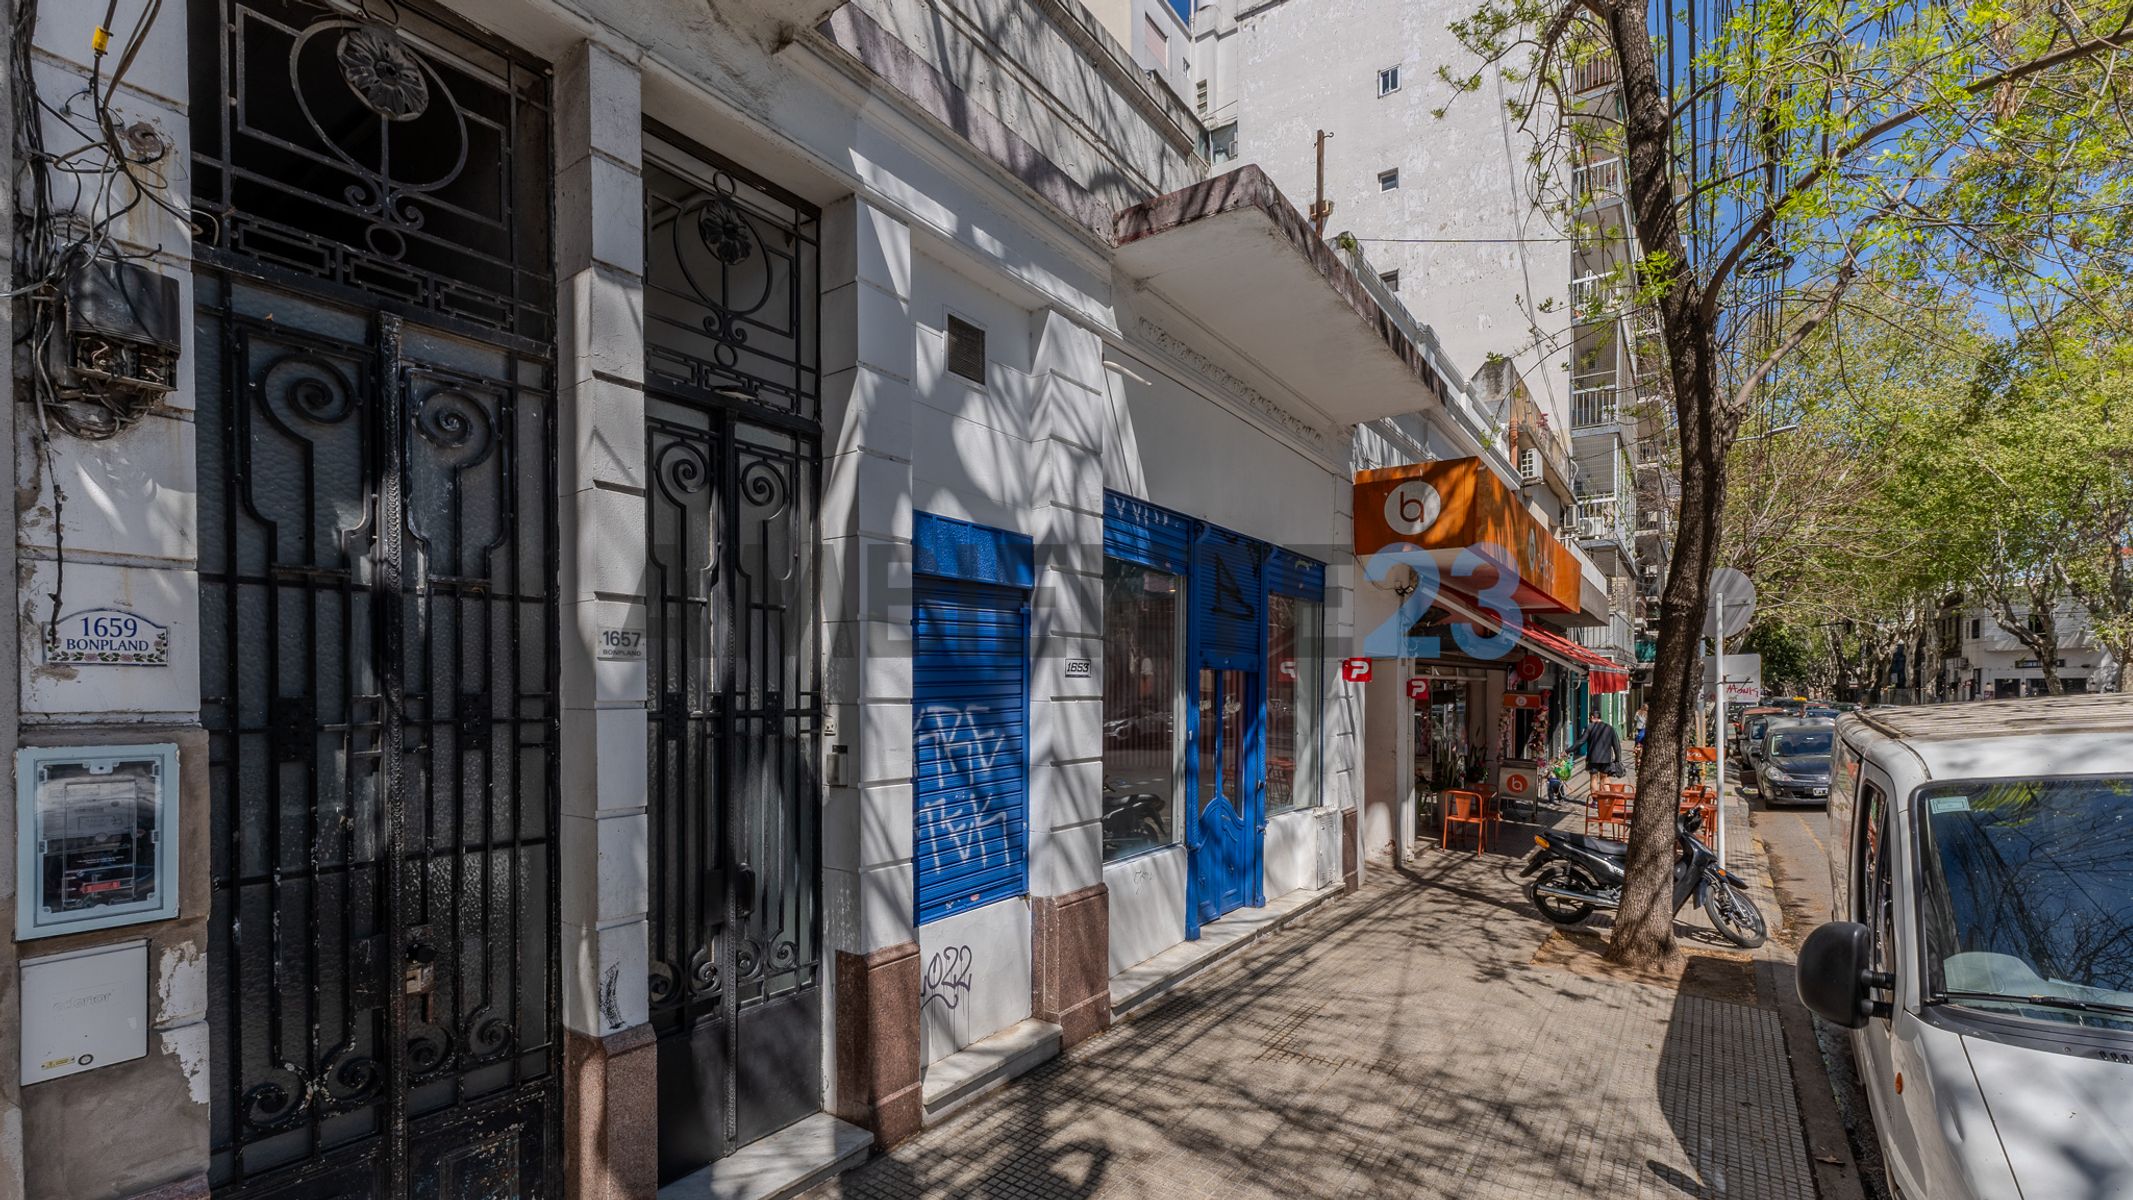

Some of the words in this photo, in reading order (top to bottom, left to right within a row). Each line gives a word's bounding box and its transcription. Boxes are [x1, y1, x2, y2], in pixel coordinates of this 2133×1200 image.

[80, 616, 137, 638] 1659
[66, 639, 149, 651] BONPLAND
[602, 630, 641, 648] 1657
[1066, 662, 1090, 673] 1653
